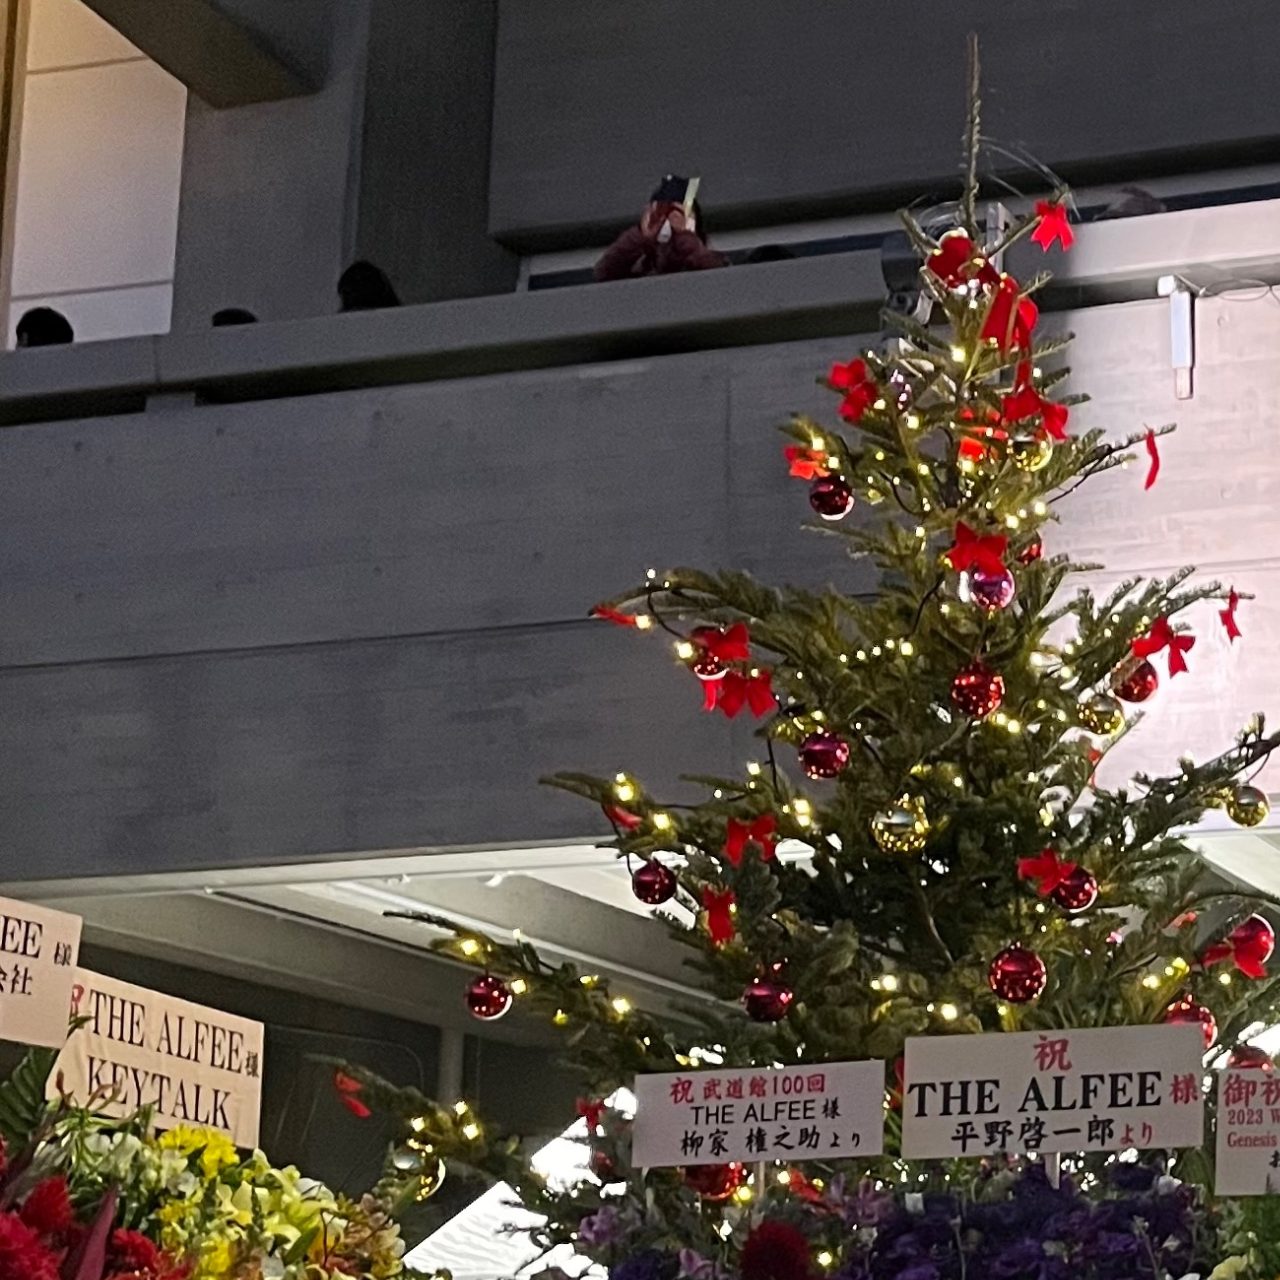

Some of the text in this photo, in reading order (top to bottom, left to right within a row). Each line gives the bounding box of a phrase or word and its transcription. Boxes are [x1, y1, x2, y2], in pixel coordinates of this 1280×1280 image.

[90, 988, 146, 1048] THE
[156, 1011, 244, 1075] ALFEE
[1033, 1034, 1072, 1071] 祝
[86, 1055, 232, 1130] KEYTALK
[670, 1073, 825, 1104] 祝 武道館100回
[908, 1071, 1198, 1117] THE ALFEE 様
[690, 1098, 842, 1125] THE ALFEE 様
[1227, 1109, 1263, 1125] 2023
[830, 1132, 860, 1148] より
[951, 1114, 1153, 1152] 平野啓一郎 より
[1227, 1131, 1278, 1148] Genesis
